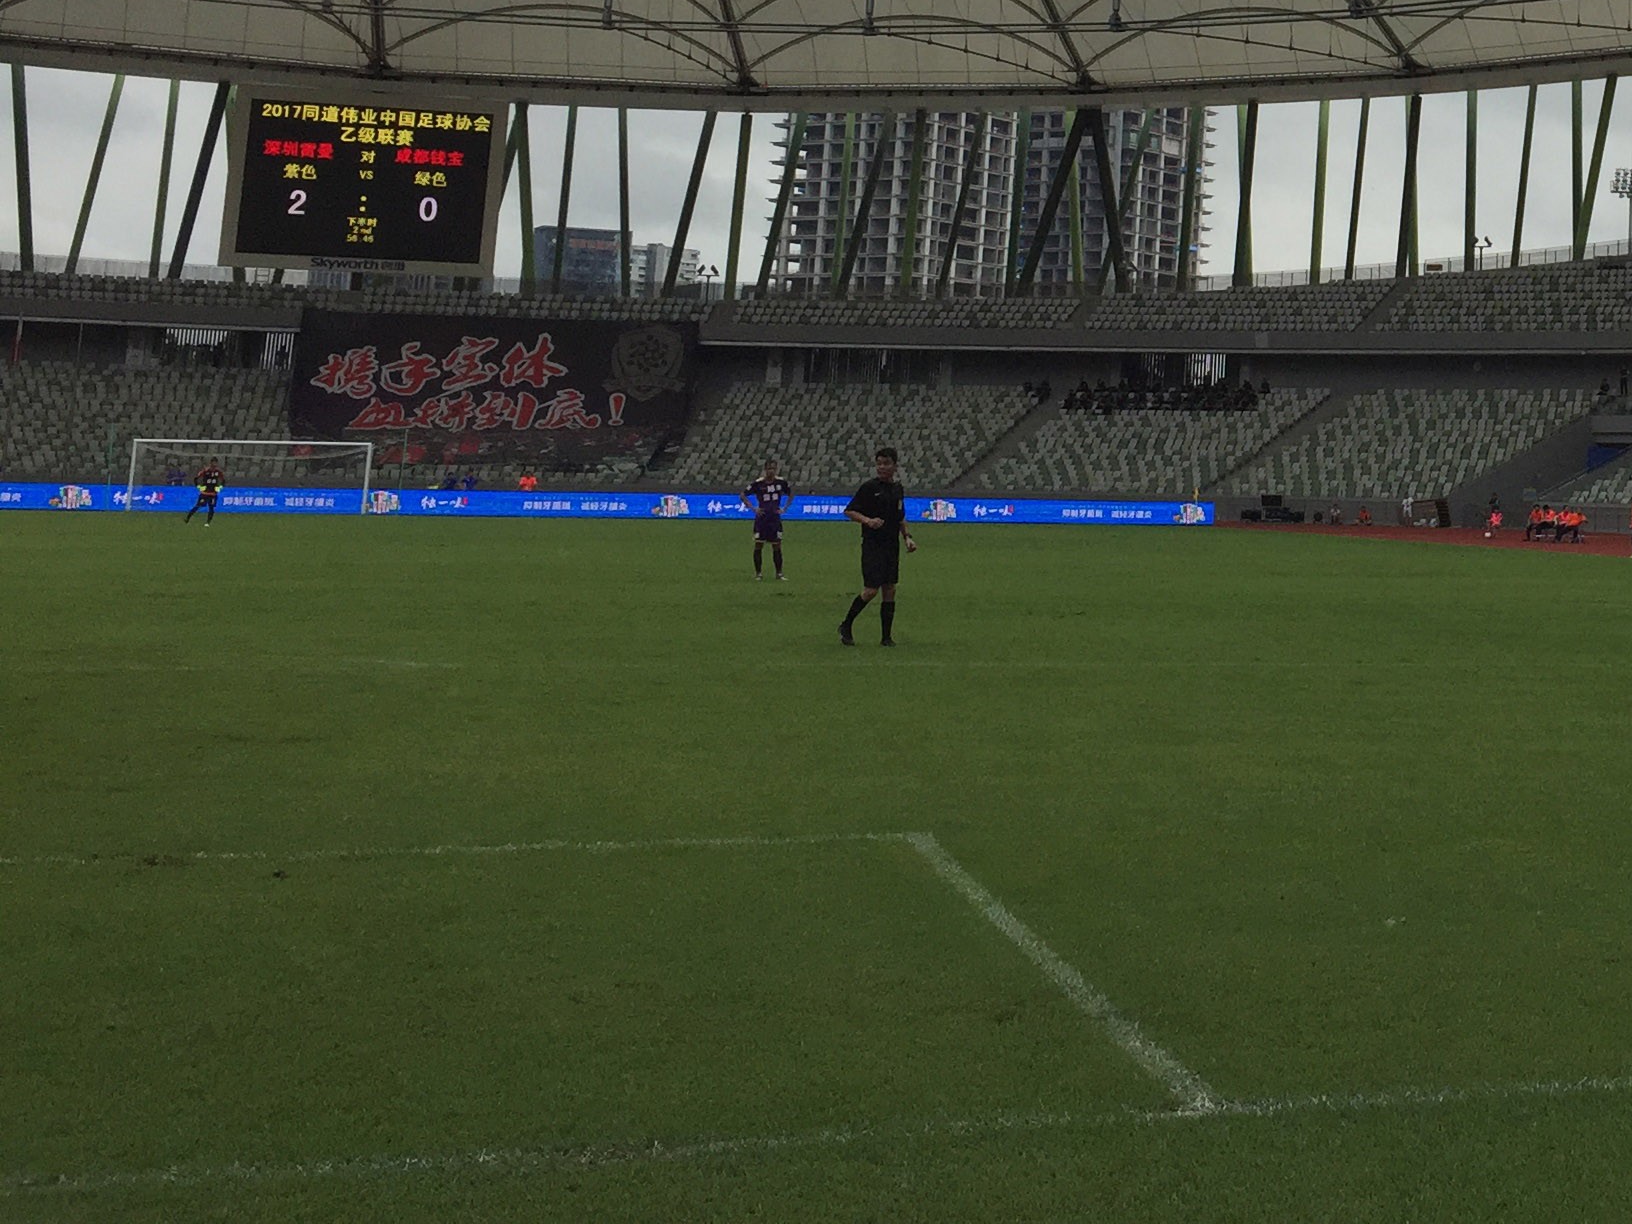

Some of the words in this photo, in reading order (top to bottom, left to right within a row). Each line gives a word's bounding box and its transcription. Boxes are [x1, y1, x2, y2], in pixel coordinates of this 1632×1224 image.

[262, 103, 490, 132] 2017同道伟业中国足球协会
[340, 126, 414, 146] 乙级联赛
[360, 150, 376, 164] 对
[283, 164, 317, 180] 紫色
[414, 171, 447, 187] 绿色
[287, 189, 307, 215] 2
[418, 196, 438, 222] 0
[310, 257, 379, 270] Skyworth
